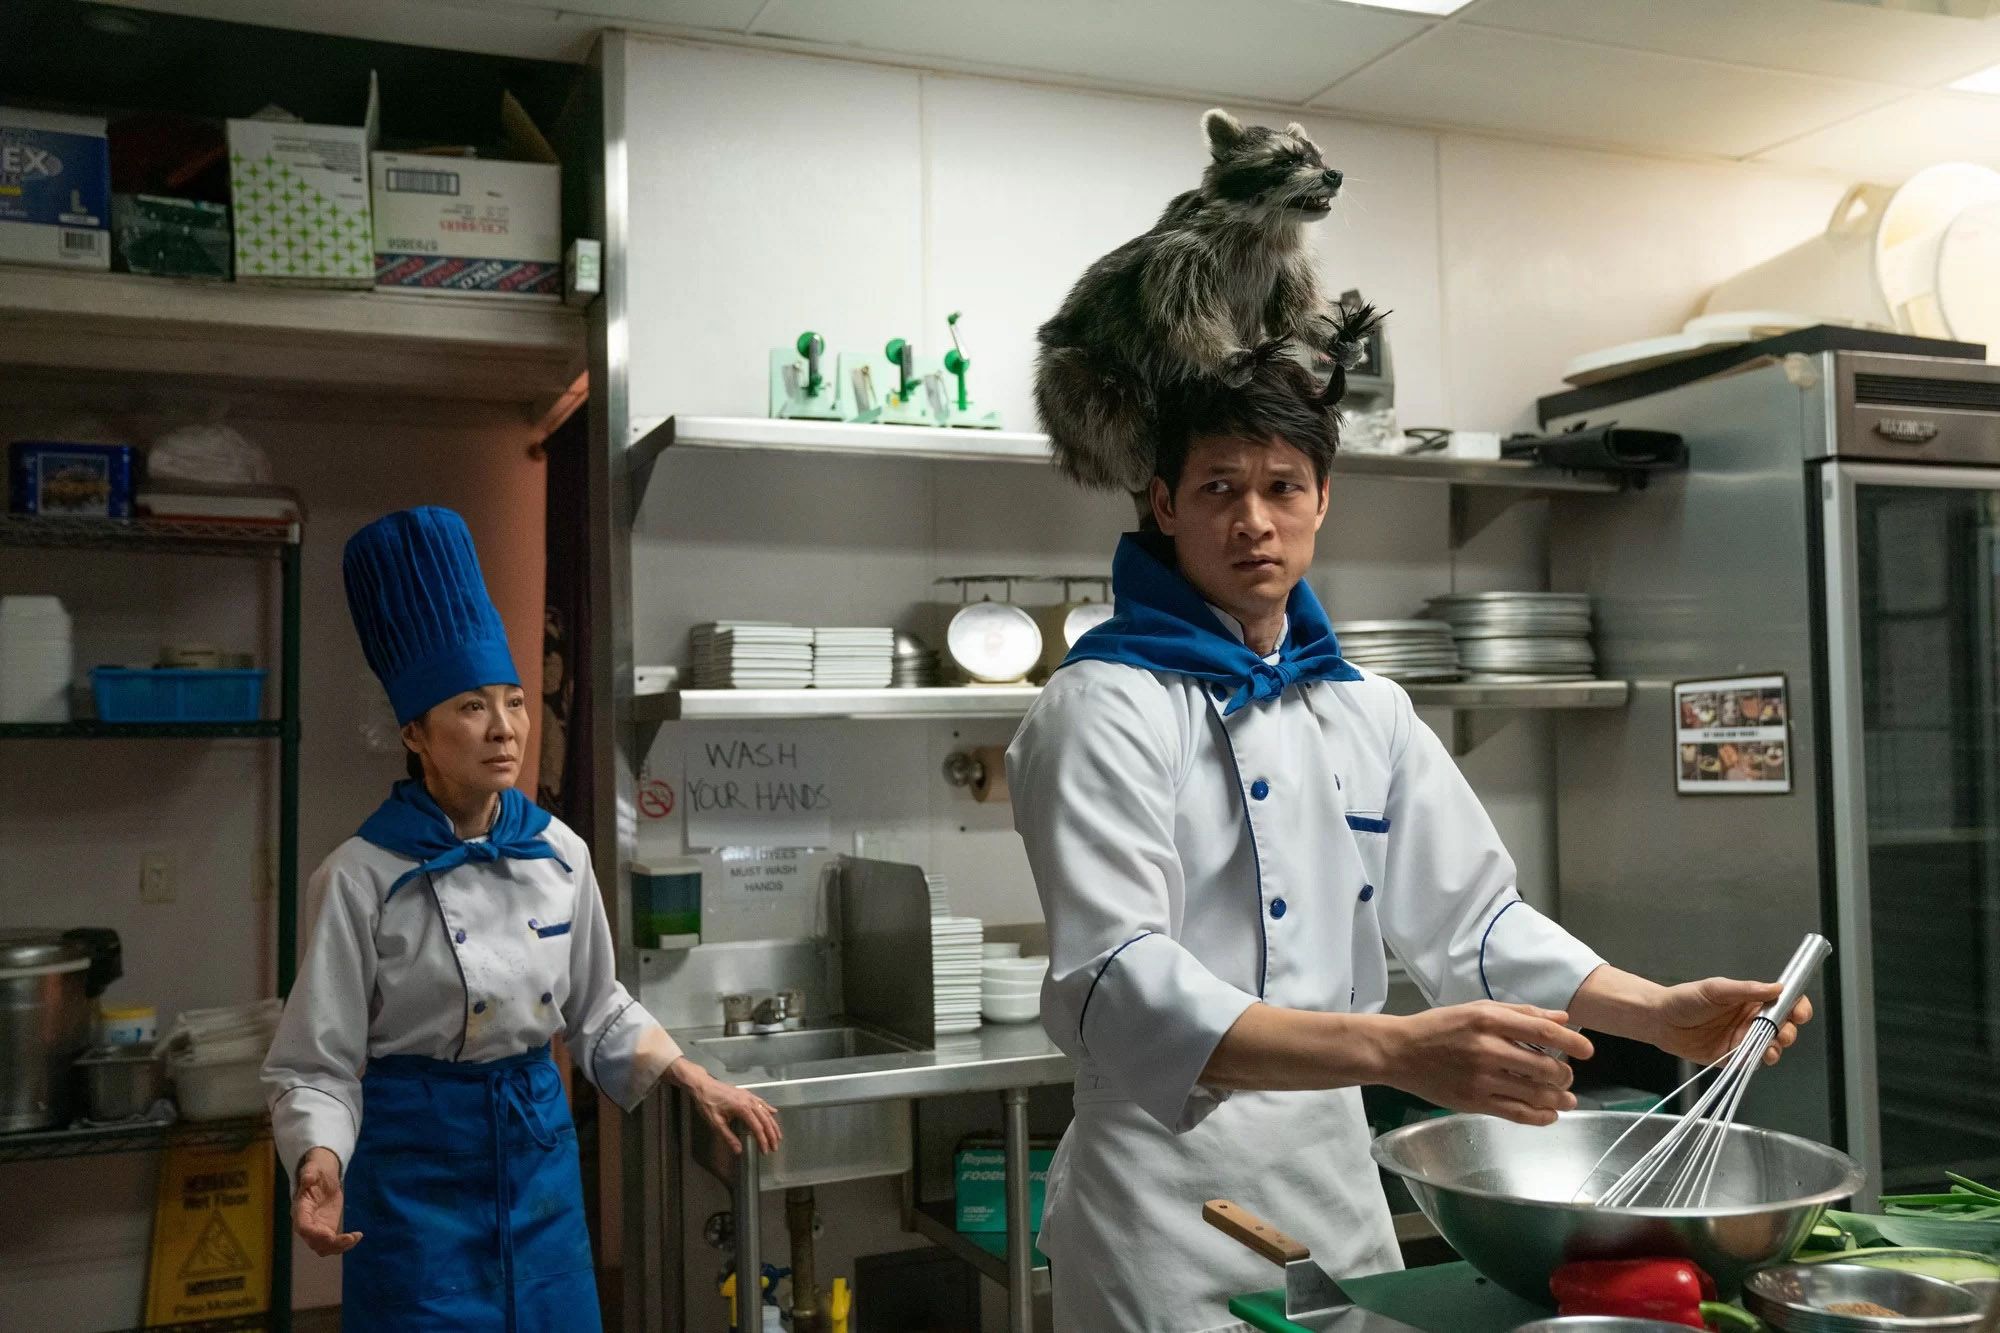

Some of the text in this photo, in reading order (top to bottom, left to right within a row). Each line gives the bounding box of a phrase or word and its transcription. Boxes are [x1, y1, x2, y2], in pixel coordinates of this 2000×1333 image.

[705, 740, 797, 769] WASH
[688, 778, 831, 812] YOUR HANDS
[730, 863, 798, 878] MUST WASH
[744, 880, 784, 893] HANDS
